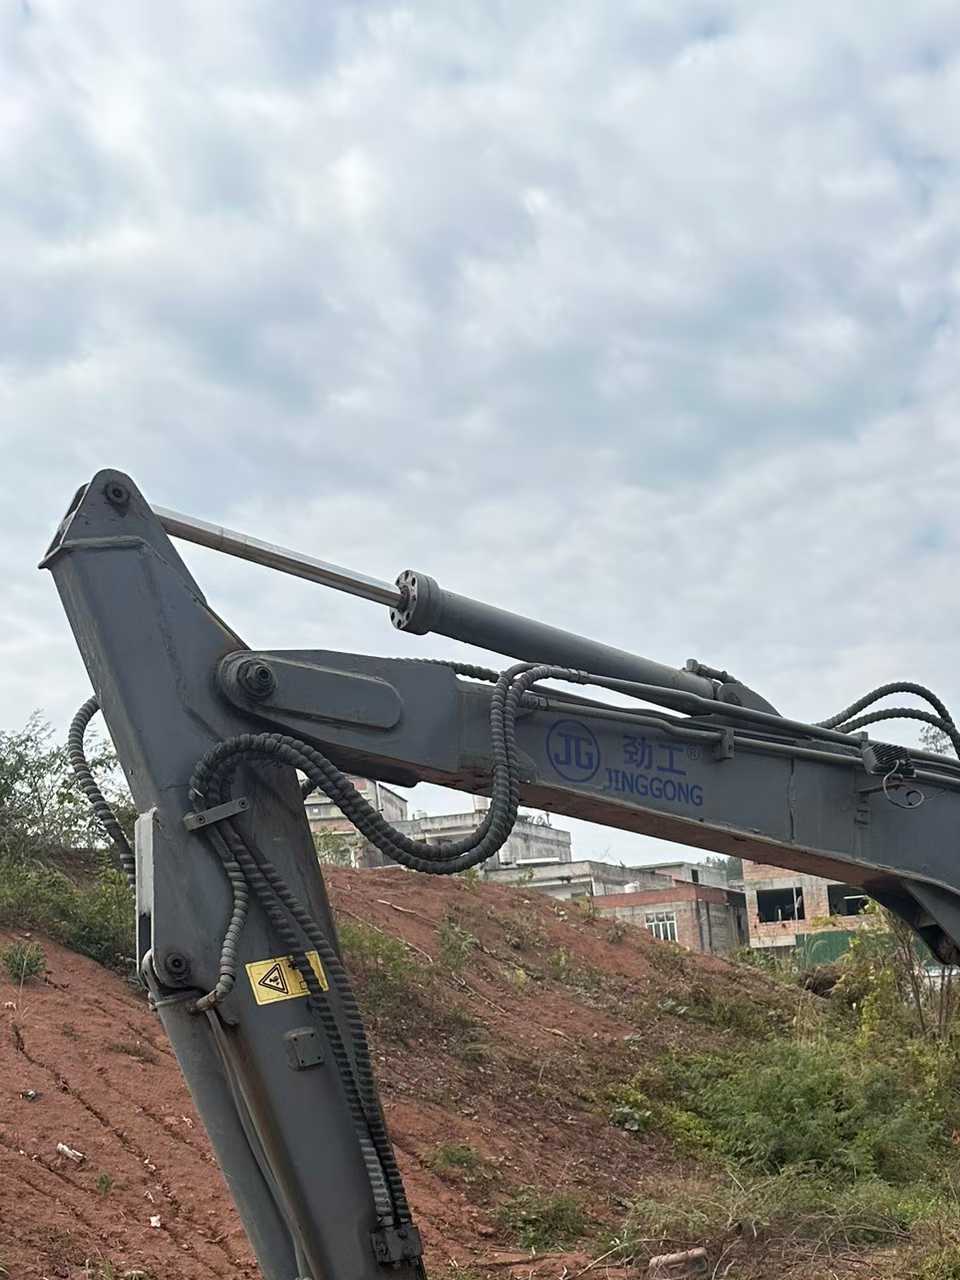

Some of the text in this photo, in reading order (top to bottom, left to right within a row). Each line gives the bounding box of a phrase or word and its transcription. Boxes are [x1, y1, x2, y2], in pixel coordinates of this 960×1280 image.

[554, 731, 594, 771] JG
[622, 735, 687, 776] 劲工
[604, 767, 704, 806] JINGGONG
